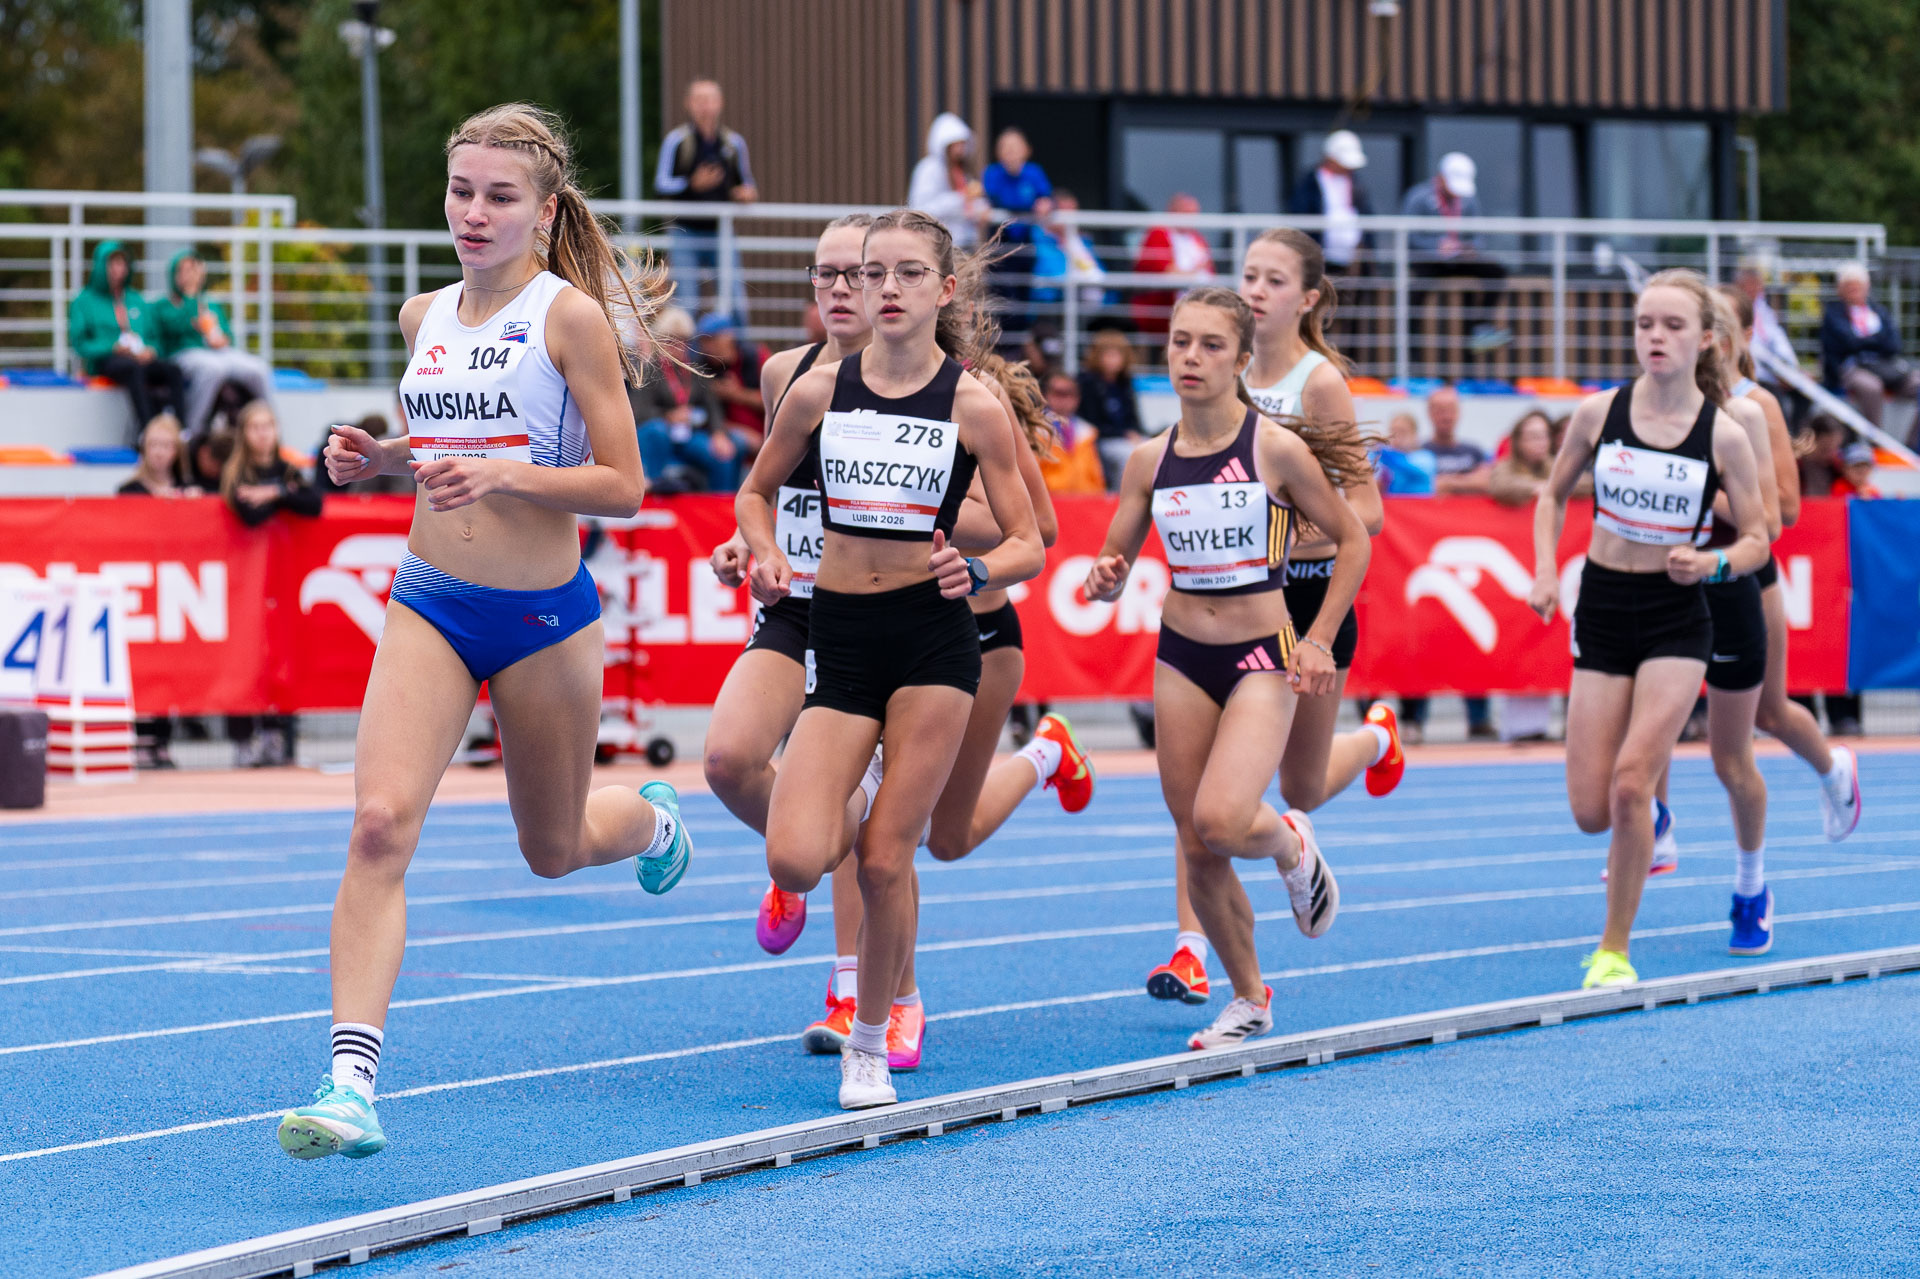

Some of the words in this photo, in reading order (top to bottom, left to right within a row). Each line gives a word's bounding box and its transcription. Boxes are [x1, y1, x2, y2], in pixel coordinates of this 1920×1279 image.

[468, 346, 511, 370] 104
[416, 367, 444, 376] ORLEN
[404, 391, 518, 420] MUSIAŁA
[894, 423, 944, 448] 278
[825, 458, 946, 493] FRASZCZYK
[1665, 463, 1688, 481] 15
[783, 493, 821, 518] 4F
[1220, 490, 1248, 509] 13
[1603, 483, 1690, 515] MOSLER
[852, 513, 878, 523] LUBIN
[880, 515, 905, 525] 2026
[1165, 509, 1191, 517] ORLEN
[1168, 526, 1255, 552] CHYŁEK
[1191, 576, 1213, 585] LUBIN
[1214, 575, 1238, 585] 2026
[1287, 559, 1336, 579] NIKE
